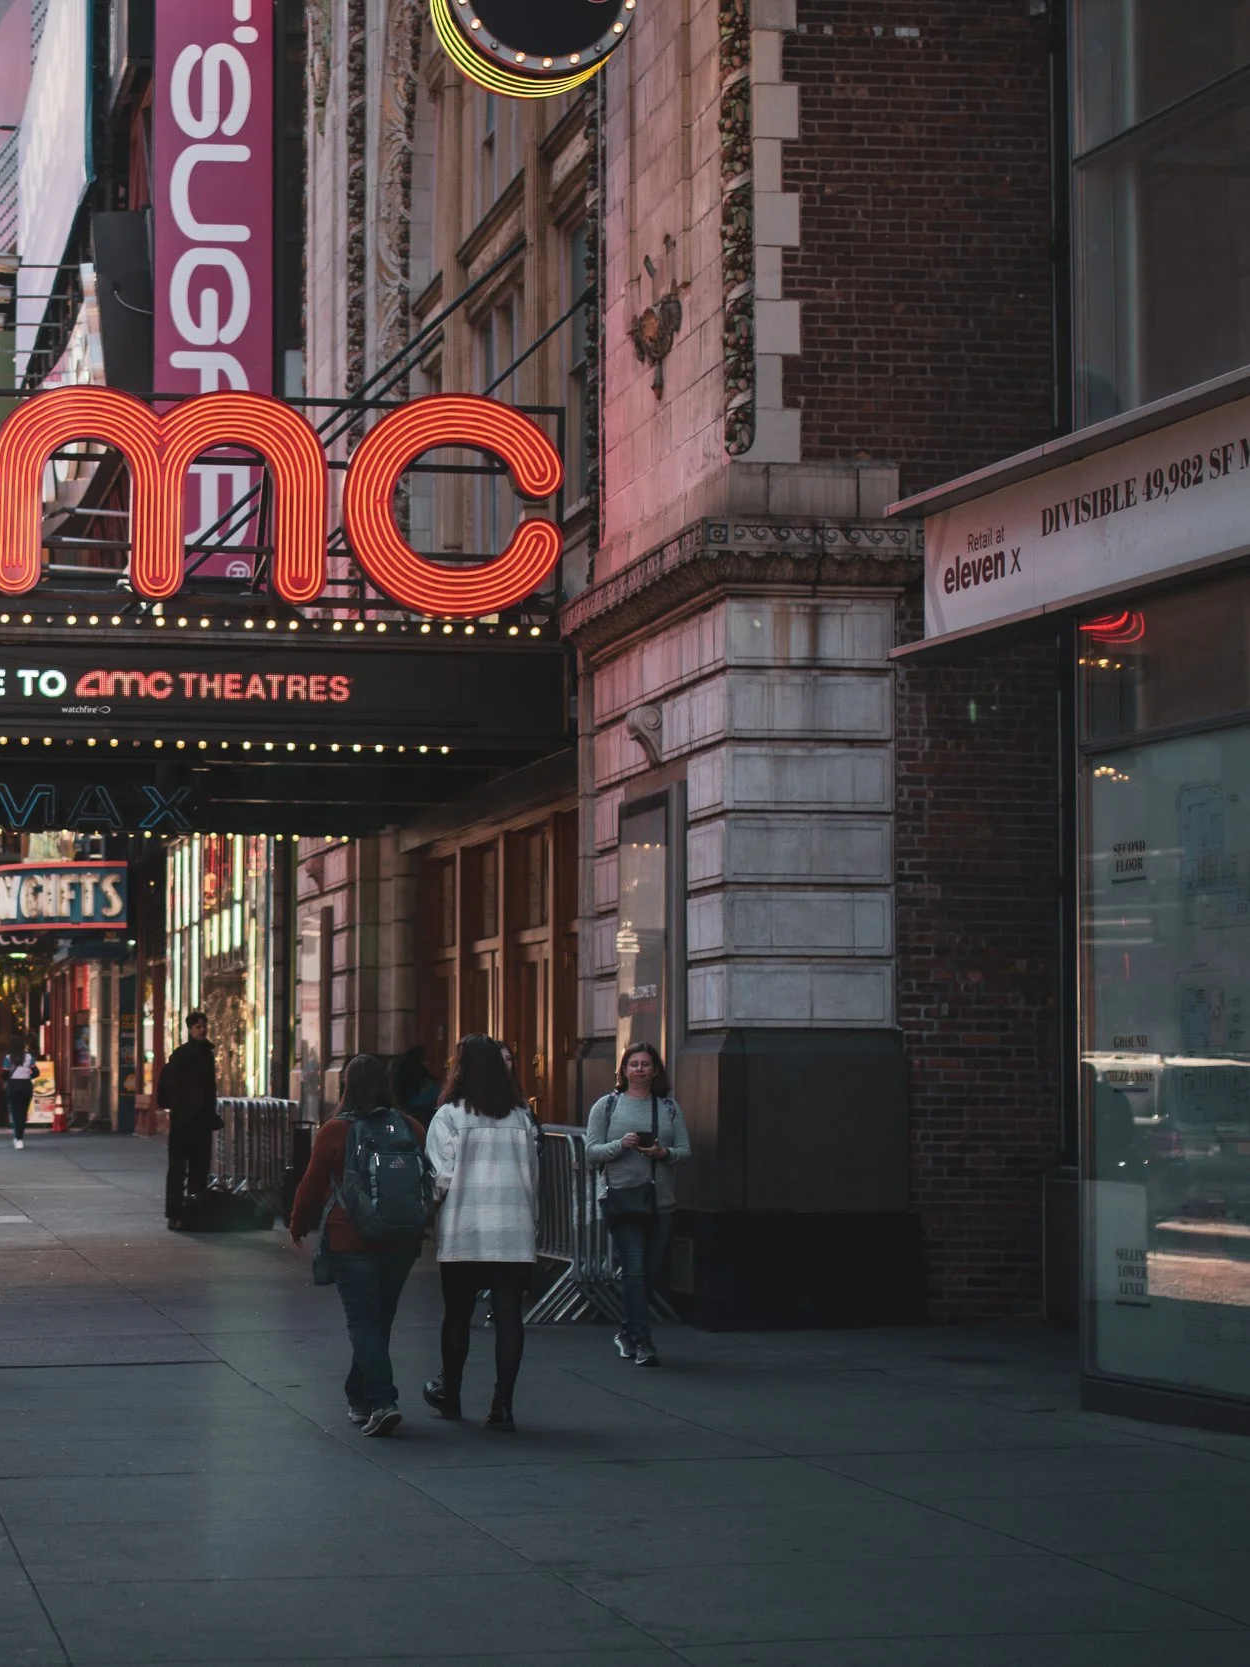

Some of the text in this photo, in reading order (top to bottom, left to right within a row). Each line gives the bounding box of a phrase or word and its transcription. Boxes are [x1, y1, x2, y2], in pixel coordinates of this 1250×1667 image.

[1041, 478, 1137, 537] DIVISIBLE
[1142, 454, 1204, 503] 49,982
[1209, 443, 1235, 480] SF
[967, 525, 1005, 553] Retail at
[944, 550, 1005, 595] eleven
[16, 669, 68, 697] TO
[75, 670, 174, 700] amc
[178, 672, 351, 702] THEATRES
[61, 705, 98, 714] watchfire
[1113, 840, 1146, 856] SECOND
[1116, 857, 1143, 873] FLOOR
[21, 872, 123, 918] GIFTS
[1113, 1034, 1148, 1048] GROUND
[1118, 1264, 1148, 1279] LOWER
[1120, 1282, 1146, 1297] LEVEL
